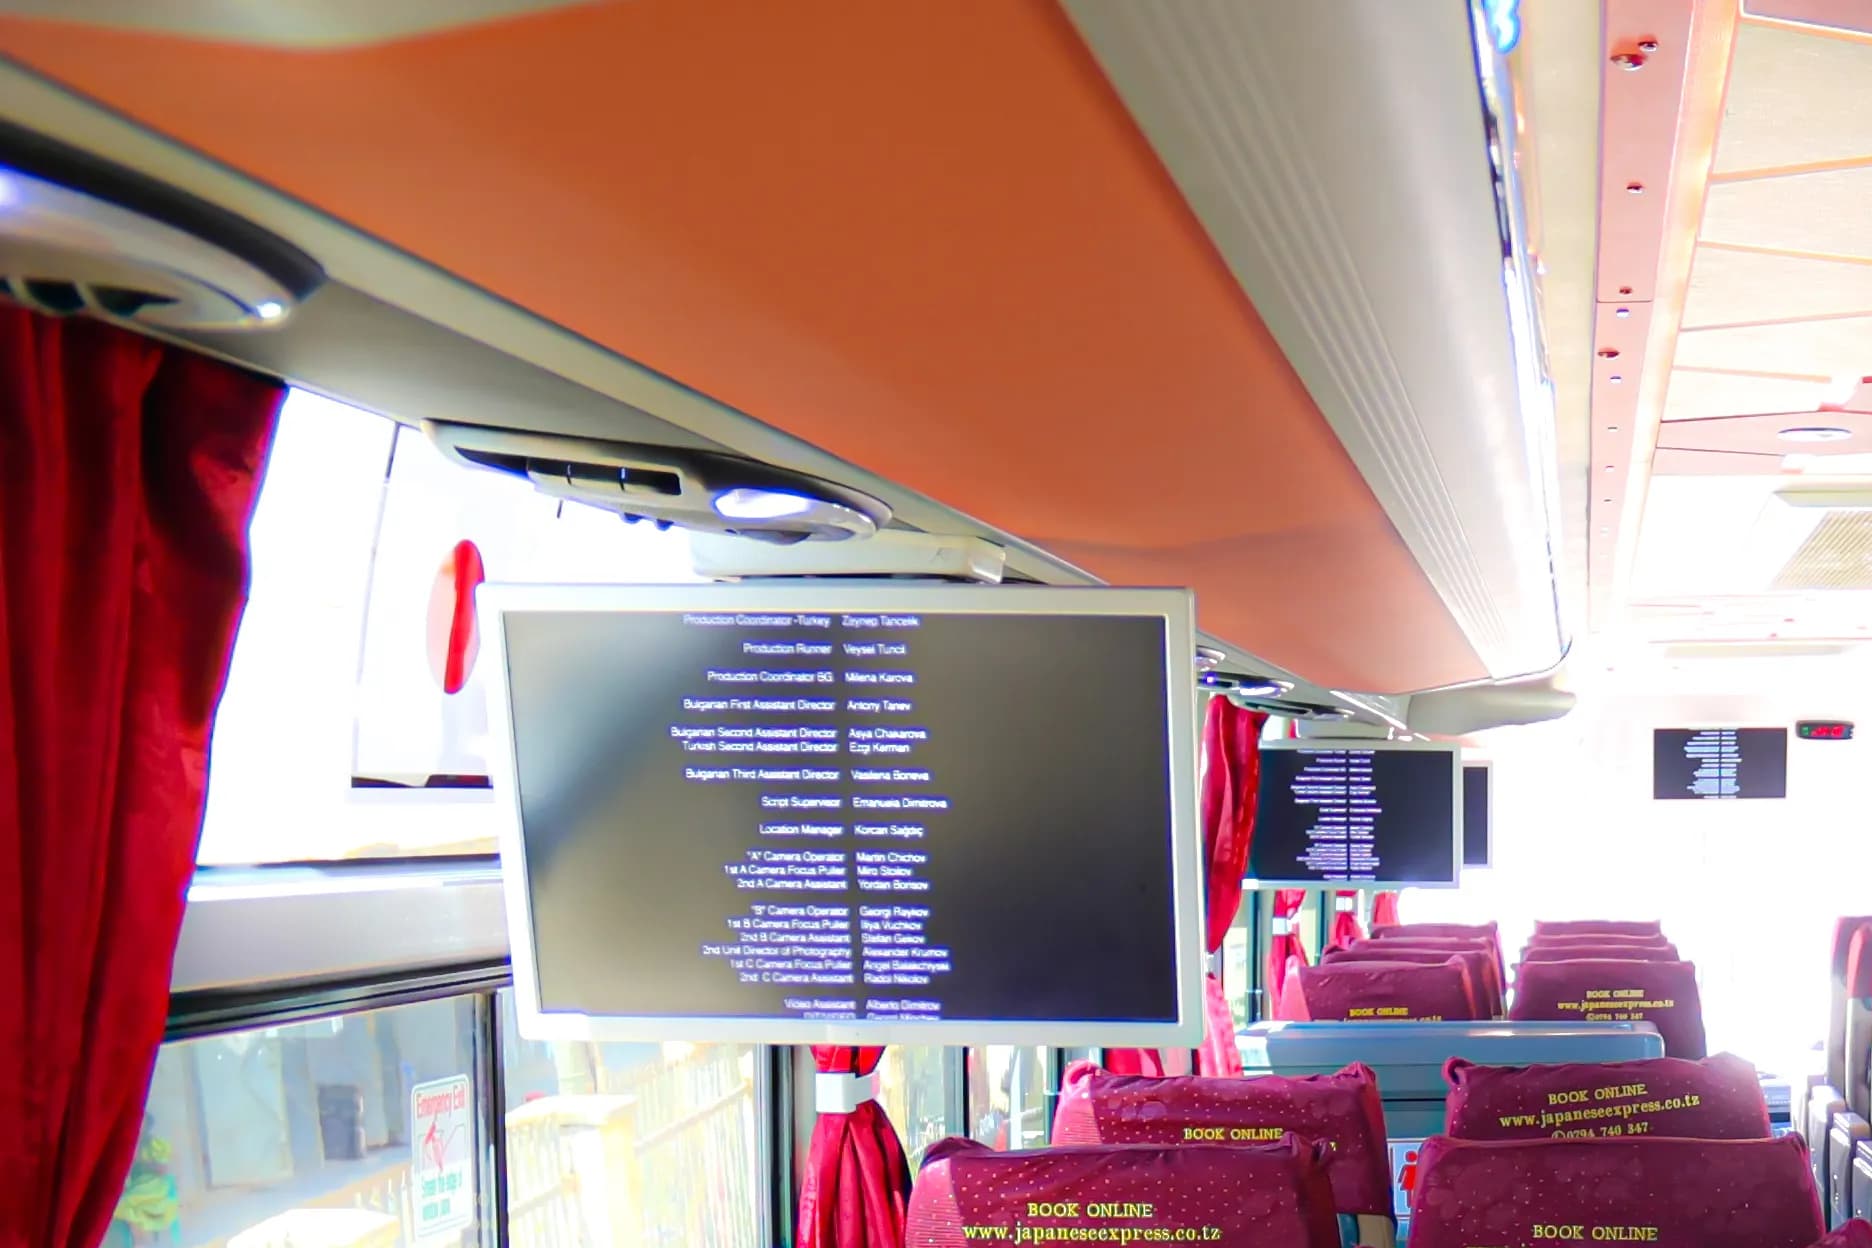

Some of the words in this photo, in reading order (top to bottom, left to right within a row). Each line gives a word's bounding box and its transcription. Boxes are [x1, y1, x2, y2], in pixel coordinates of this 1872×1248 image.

[1548, 1090, 1589, 1105] BOOK
[1595, 1084, 1648, 1099] ONLINE
[1499, 1094, 1700, 1128] www.japaneseexpress.co.tz
[1184, 1128, 1225, 1140] BOOK
[1230, 1128, 1283, 1140] ONLINE
[1600, 1125, 1622, 1136] 740
[1628, 1122, 1648, 1133] 347
[1027, 1203, 1079, 1217] BOOK
[1087, 1203, 1153, 1218] ONLINE
[962, 1221, 1222, 1245] www.japaneseexpress.co.tz
[1533, 1224, 1584, 1239] BOOK
[1592, 1226, 1658, 1241] ONLINE
